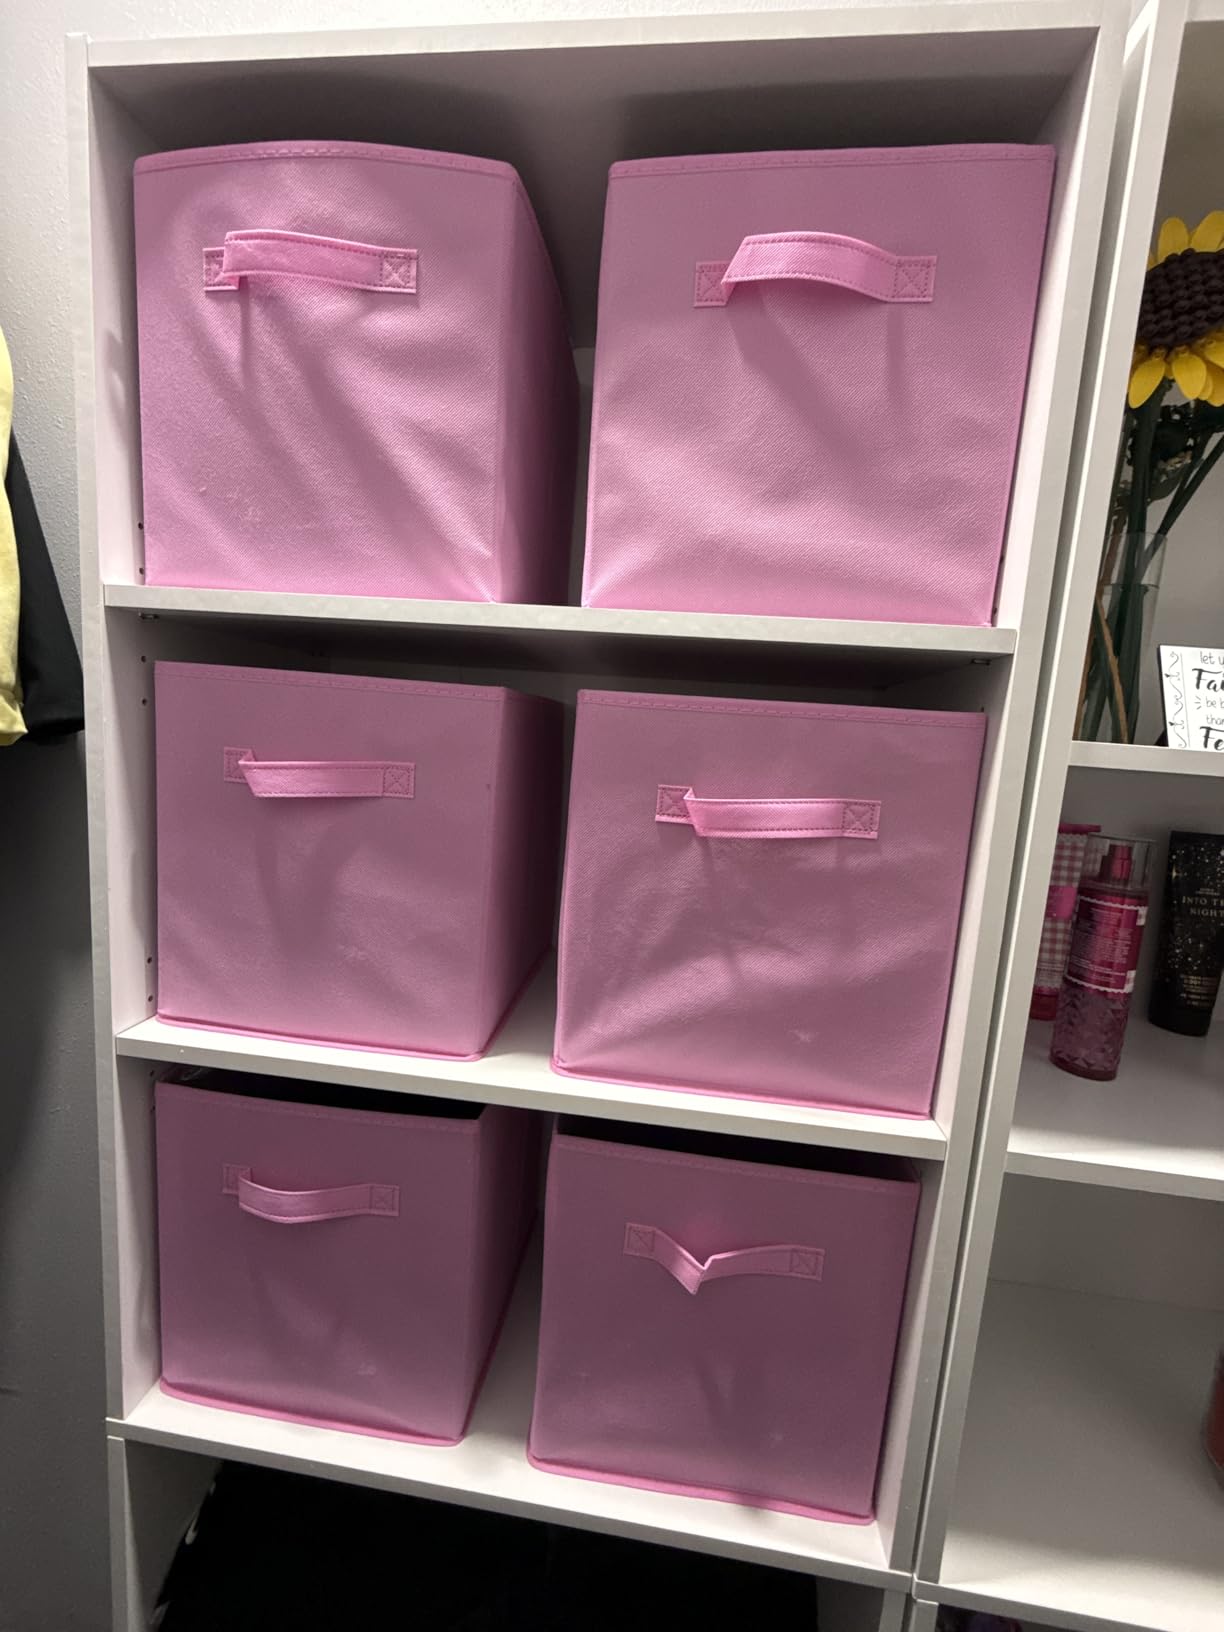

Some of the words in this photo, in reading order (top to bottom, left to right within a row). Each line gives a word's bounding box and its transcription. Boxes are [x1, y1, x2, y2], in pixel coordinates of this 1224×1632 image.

[1199, 650, 1216, 665] let
[1206, 696, 1217, 709] be
[1182, 895, 1208, 906] INTO
